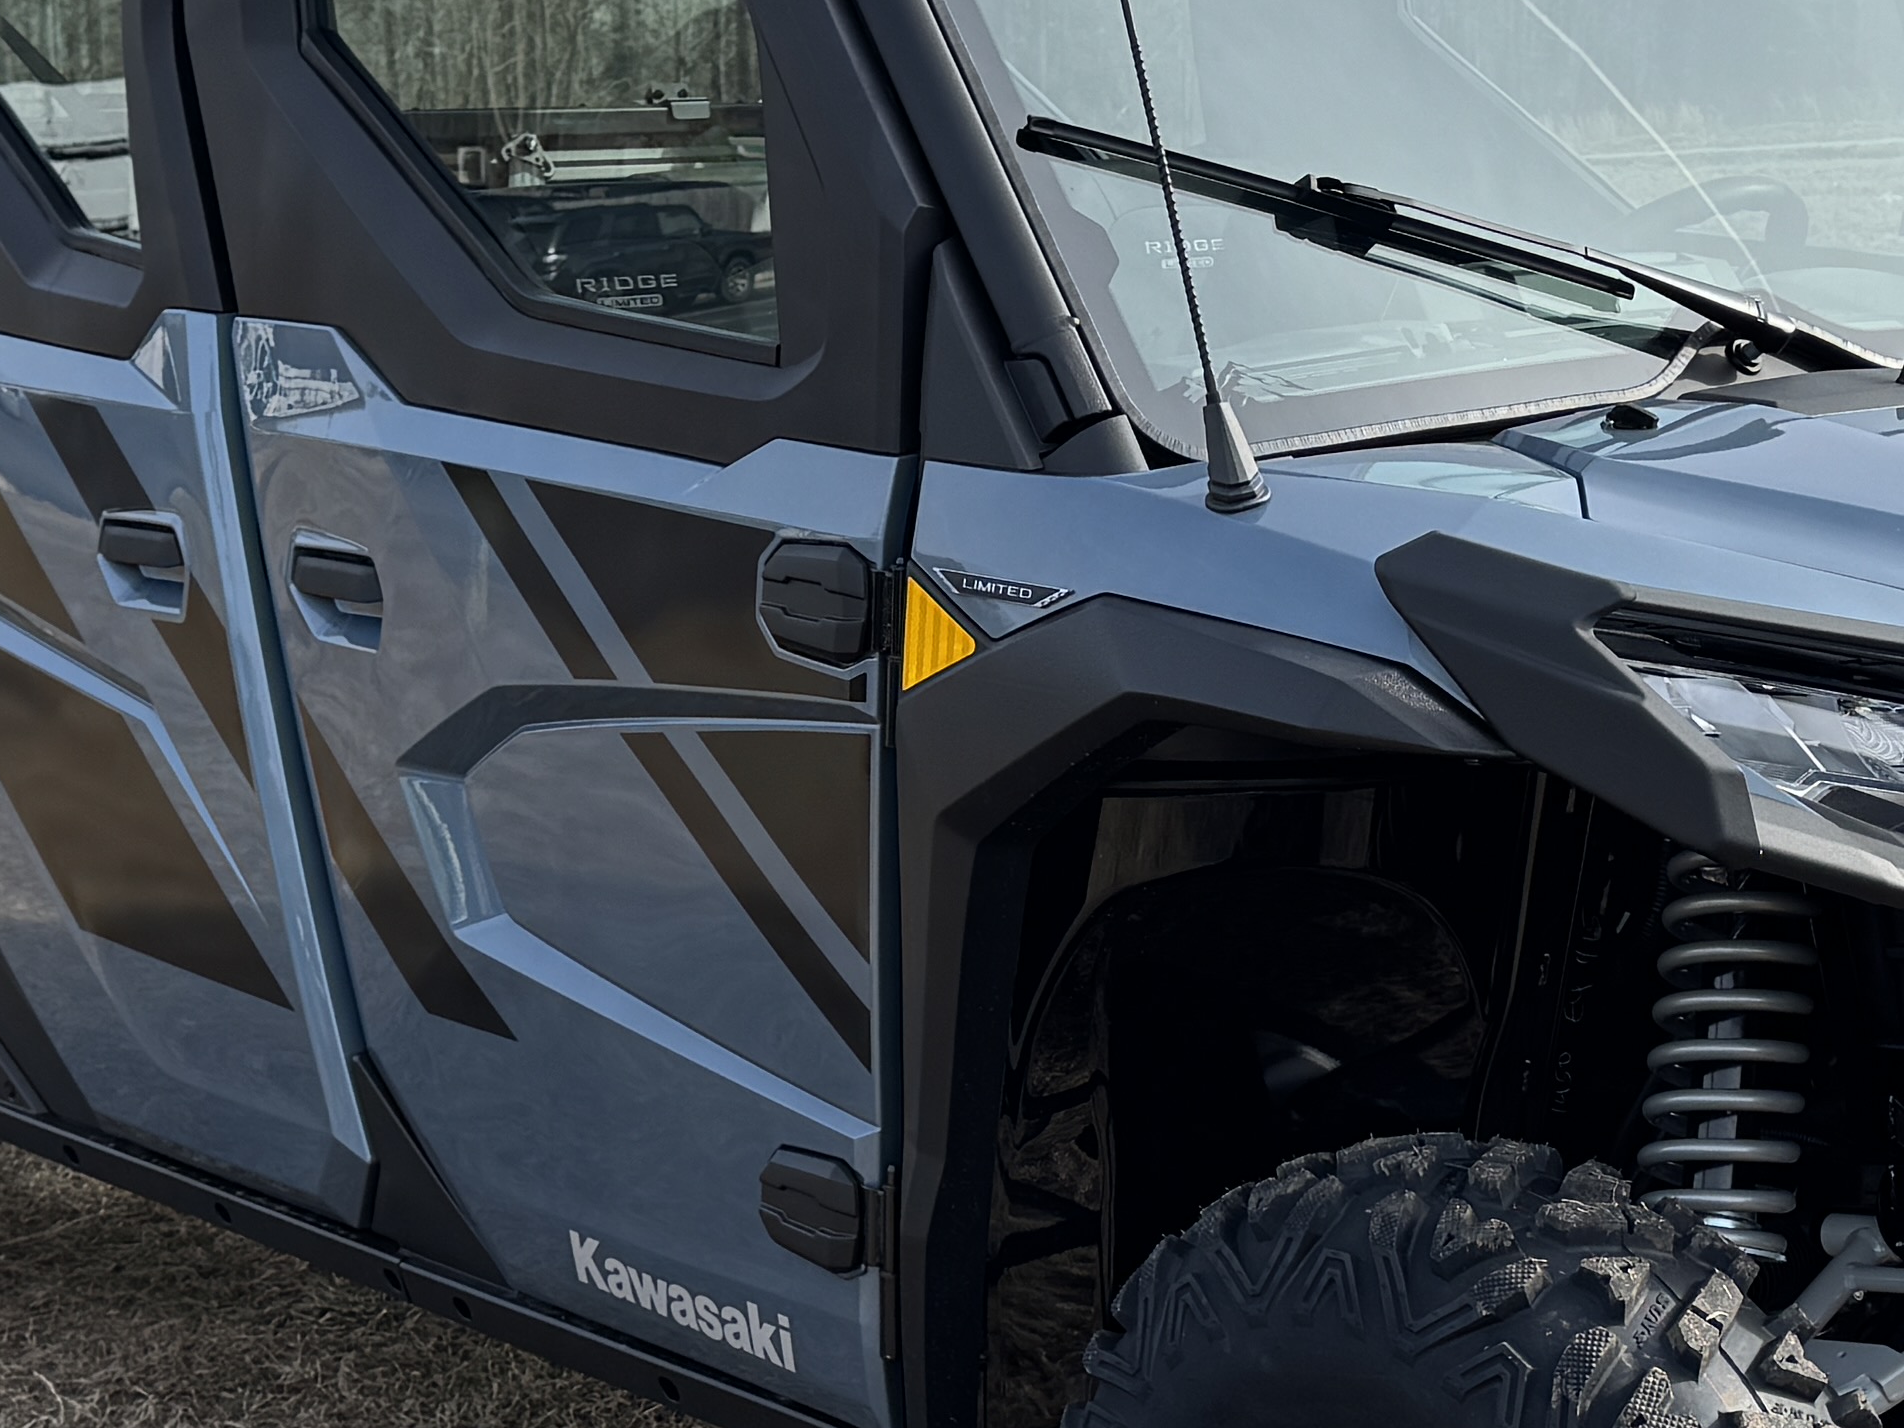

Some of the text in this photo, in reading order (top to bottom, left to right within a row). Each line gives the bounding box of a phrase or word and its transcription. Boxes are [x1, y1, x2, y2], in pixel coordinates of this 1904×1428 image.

[576, 274, 678, 293] RIDGE
[962, 577, 1033, 599] LIMITED
[569, 1229, 796, 1372] Kawasaki
